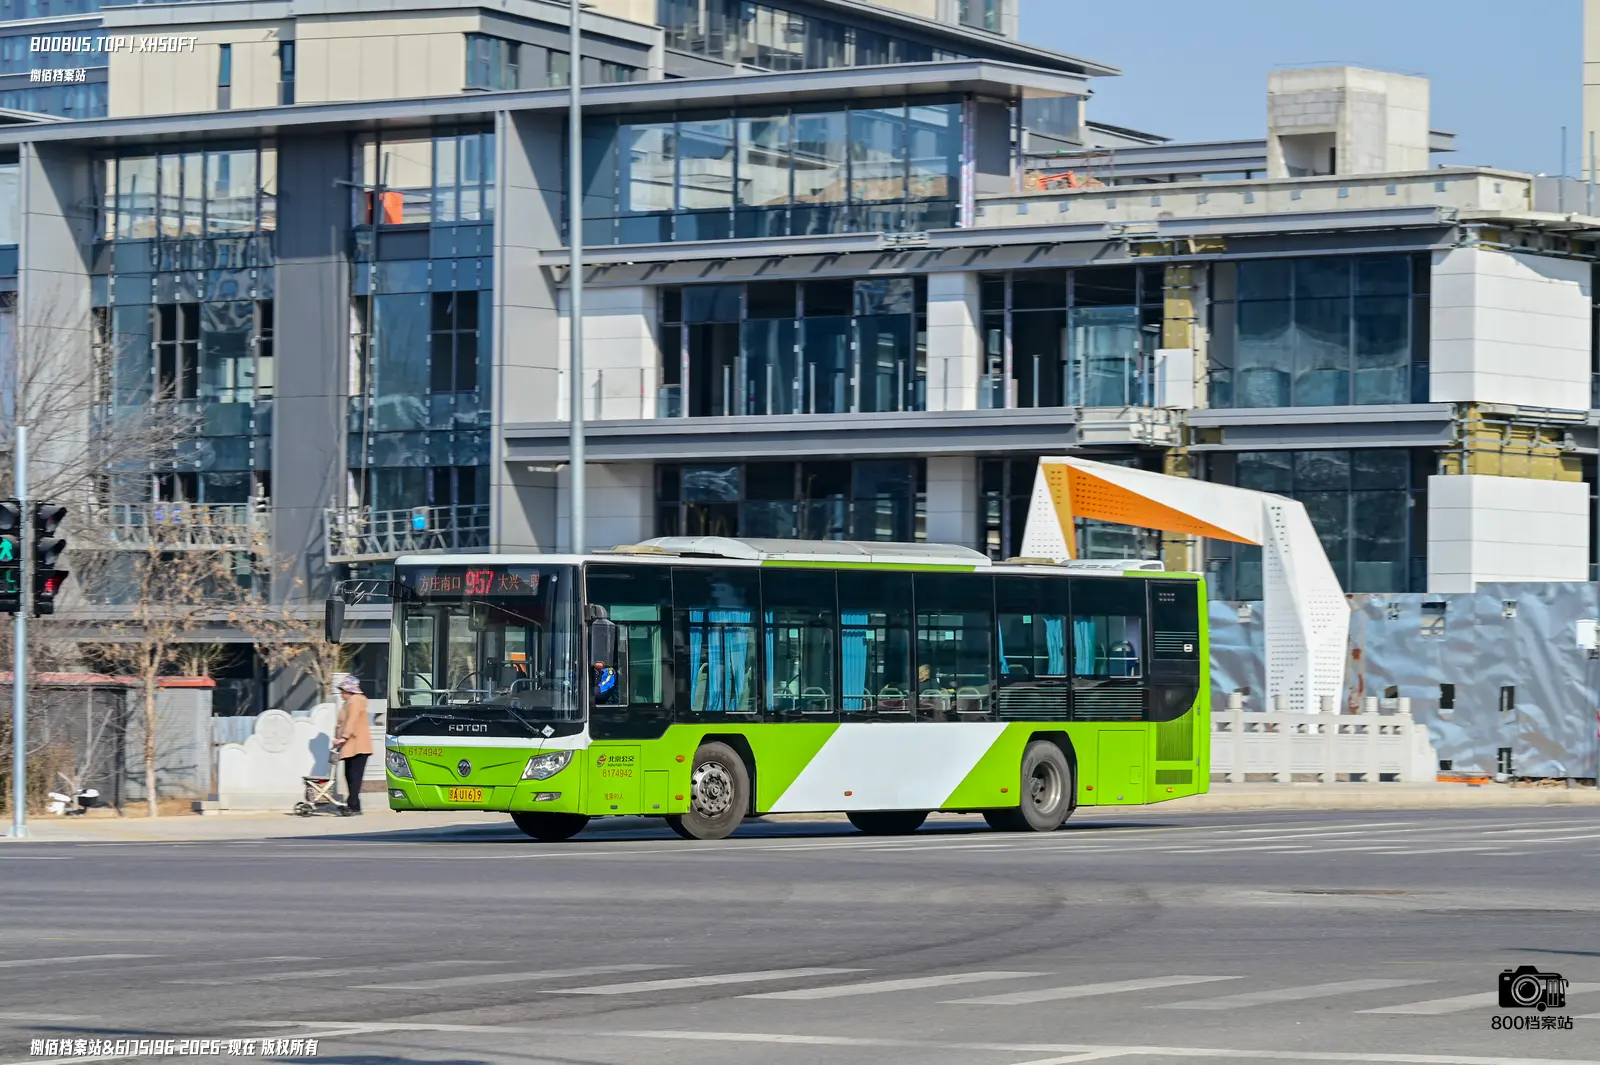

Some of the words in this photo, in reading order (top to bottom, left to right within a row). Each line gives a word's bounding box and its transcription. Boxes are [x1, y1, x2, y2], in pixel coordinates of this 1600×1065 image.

[420, 575, 461, 592] 方庄南口
[465, 570, 494, 595] 957
[448, 724, 488, 732] FOTON
[408, 747, 443, 757] 6174942
[608, 755, 634, 763] 北京公交
[602, 768, 633, 778] 6174942
